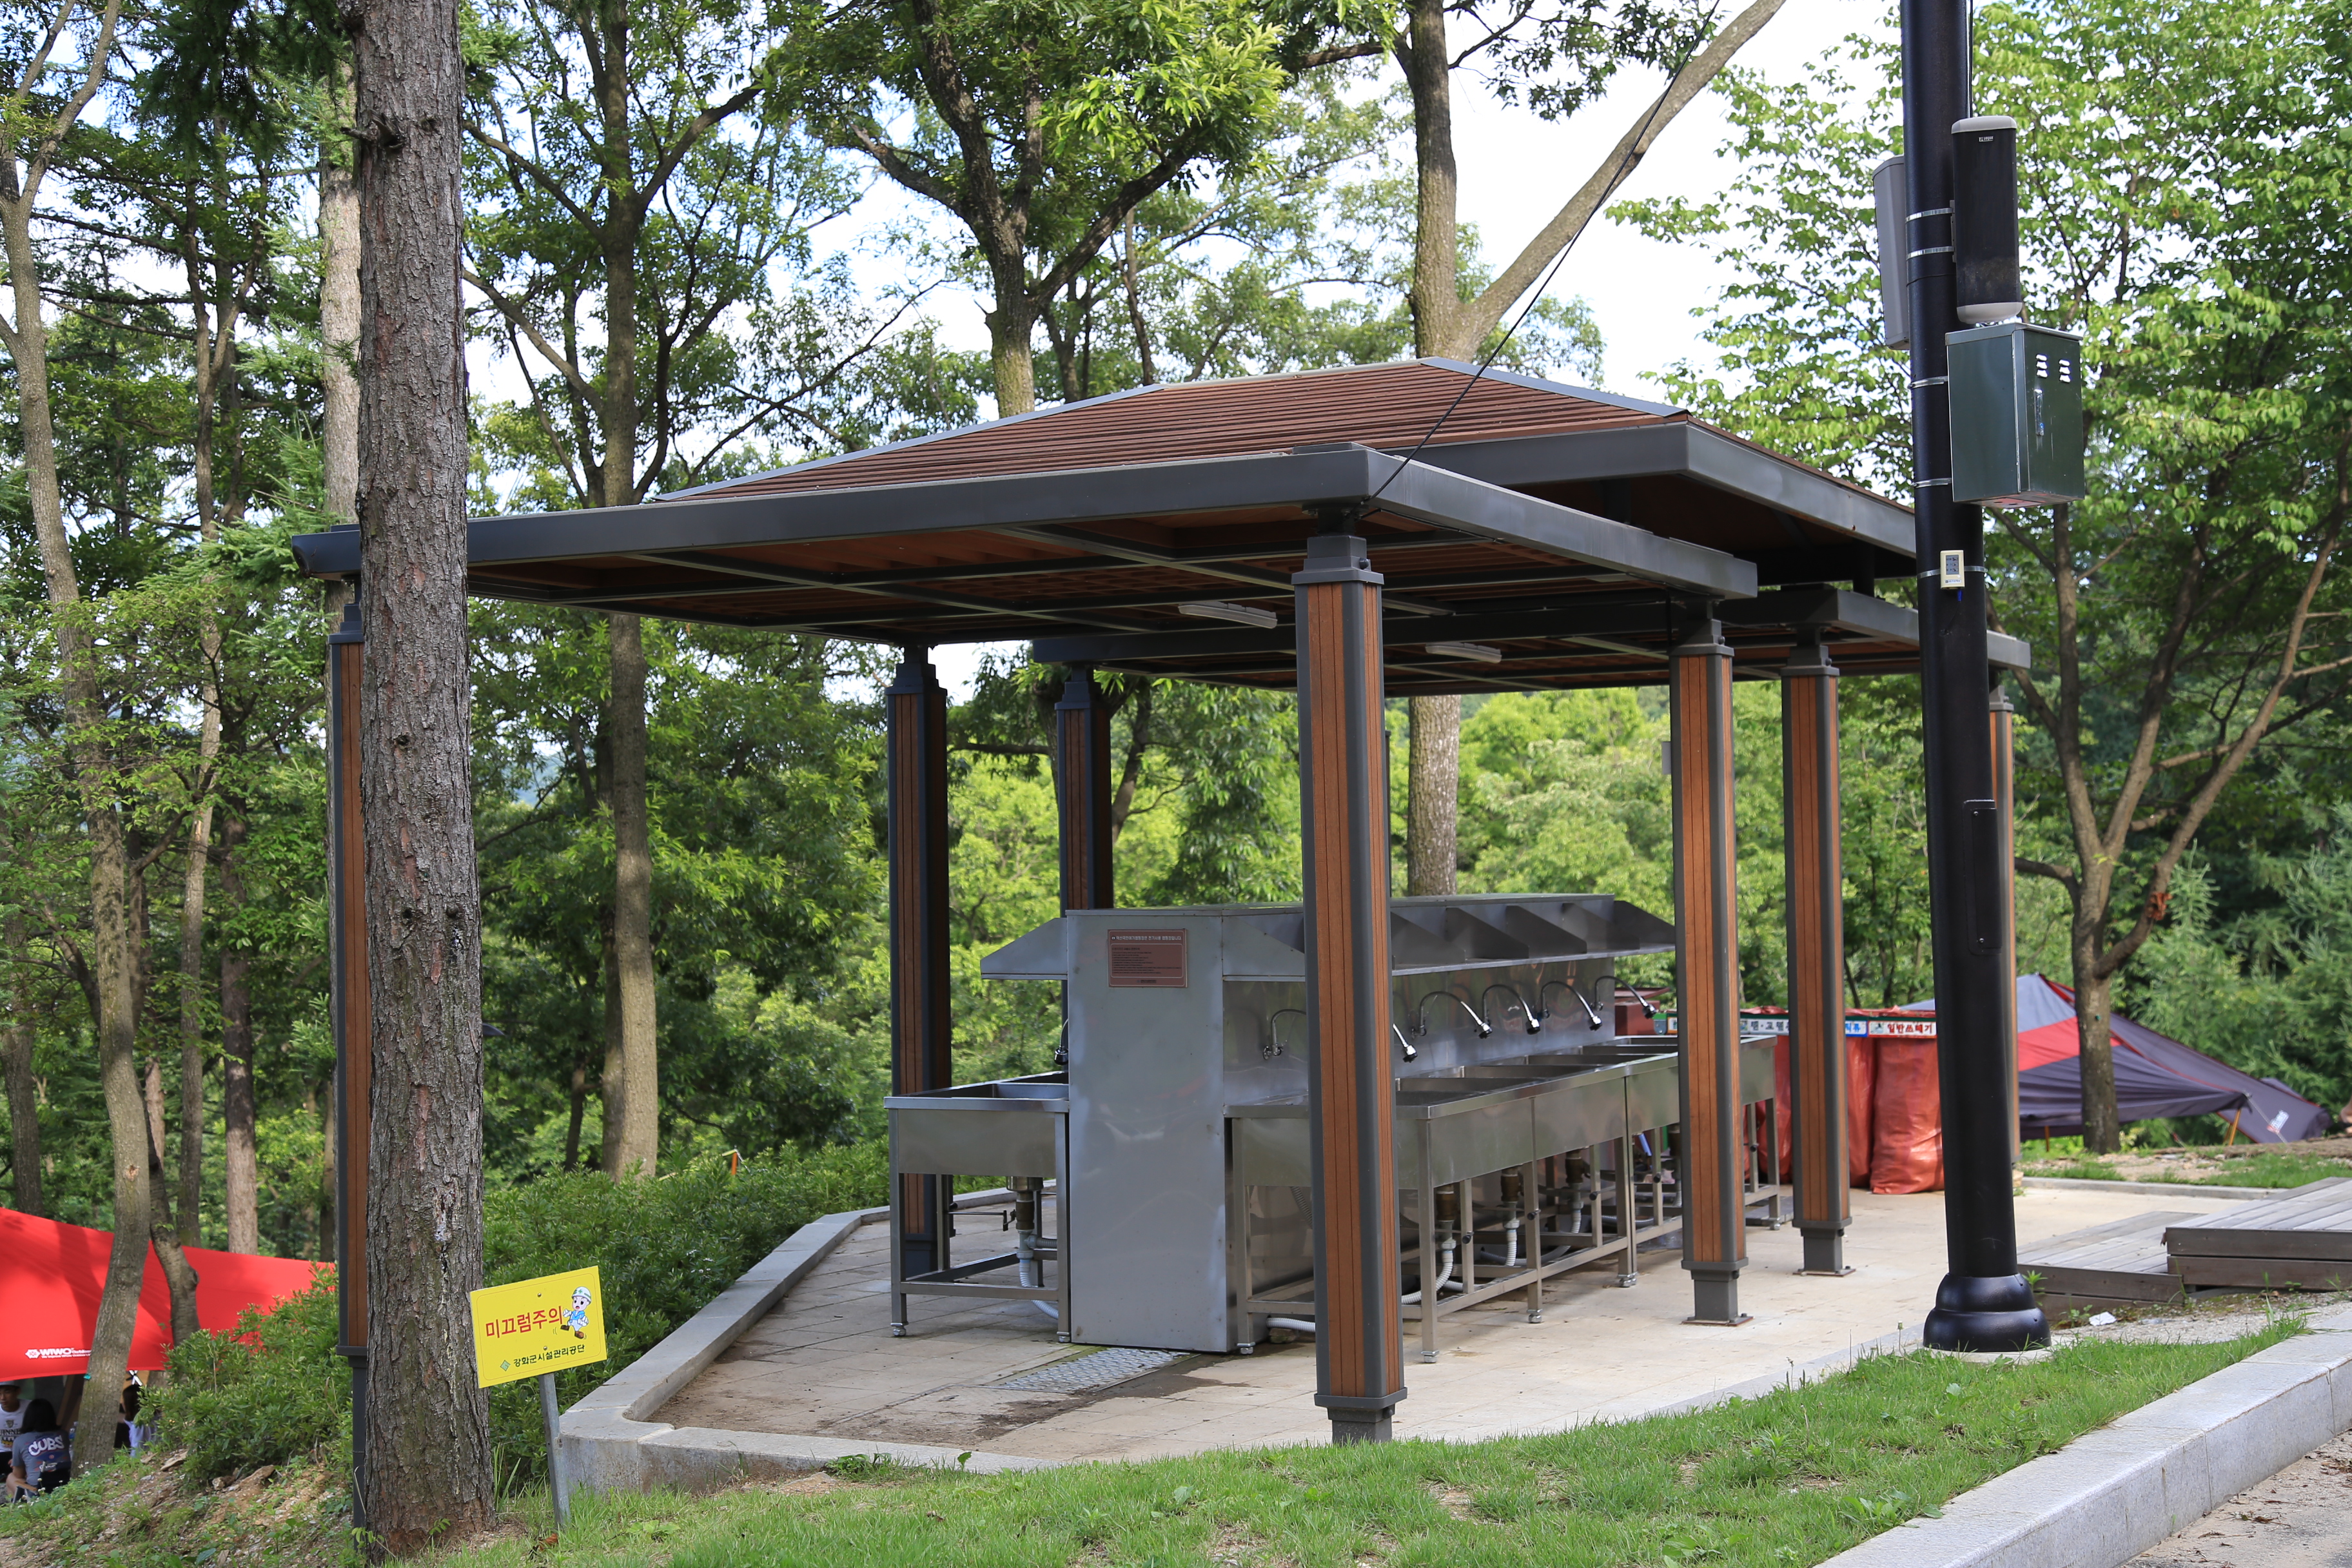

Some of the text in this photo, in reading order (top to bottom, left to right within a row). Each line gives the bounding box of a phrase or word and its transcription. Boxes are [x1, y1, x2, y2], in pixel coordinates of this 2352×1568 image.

[1887, 1023, 1932, 1034] 일반쓰레기
[485, 1306, 564, 1338] 미끄럼주의
[513, 1344, 585, 1367] 강화군시설관리공단
[28, 1435, 64, 1456] CUBS
